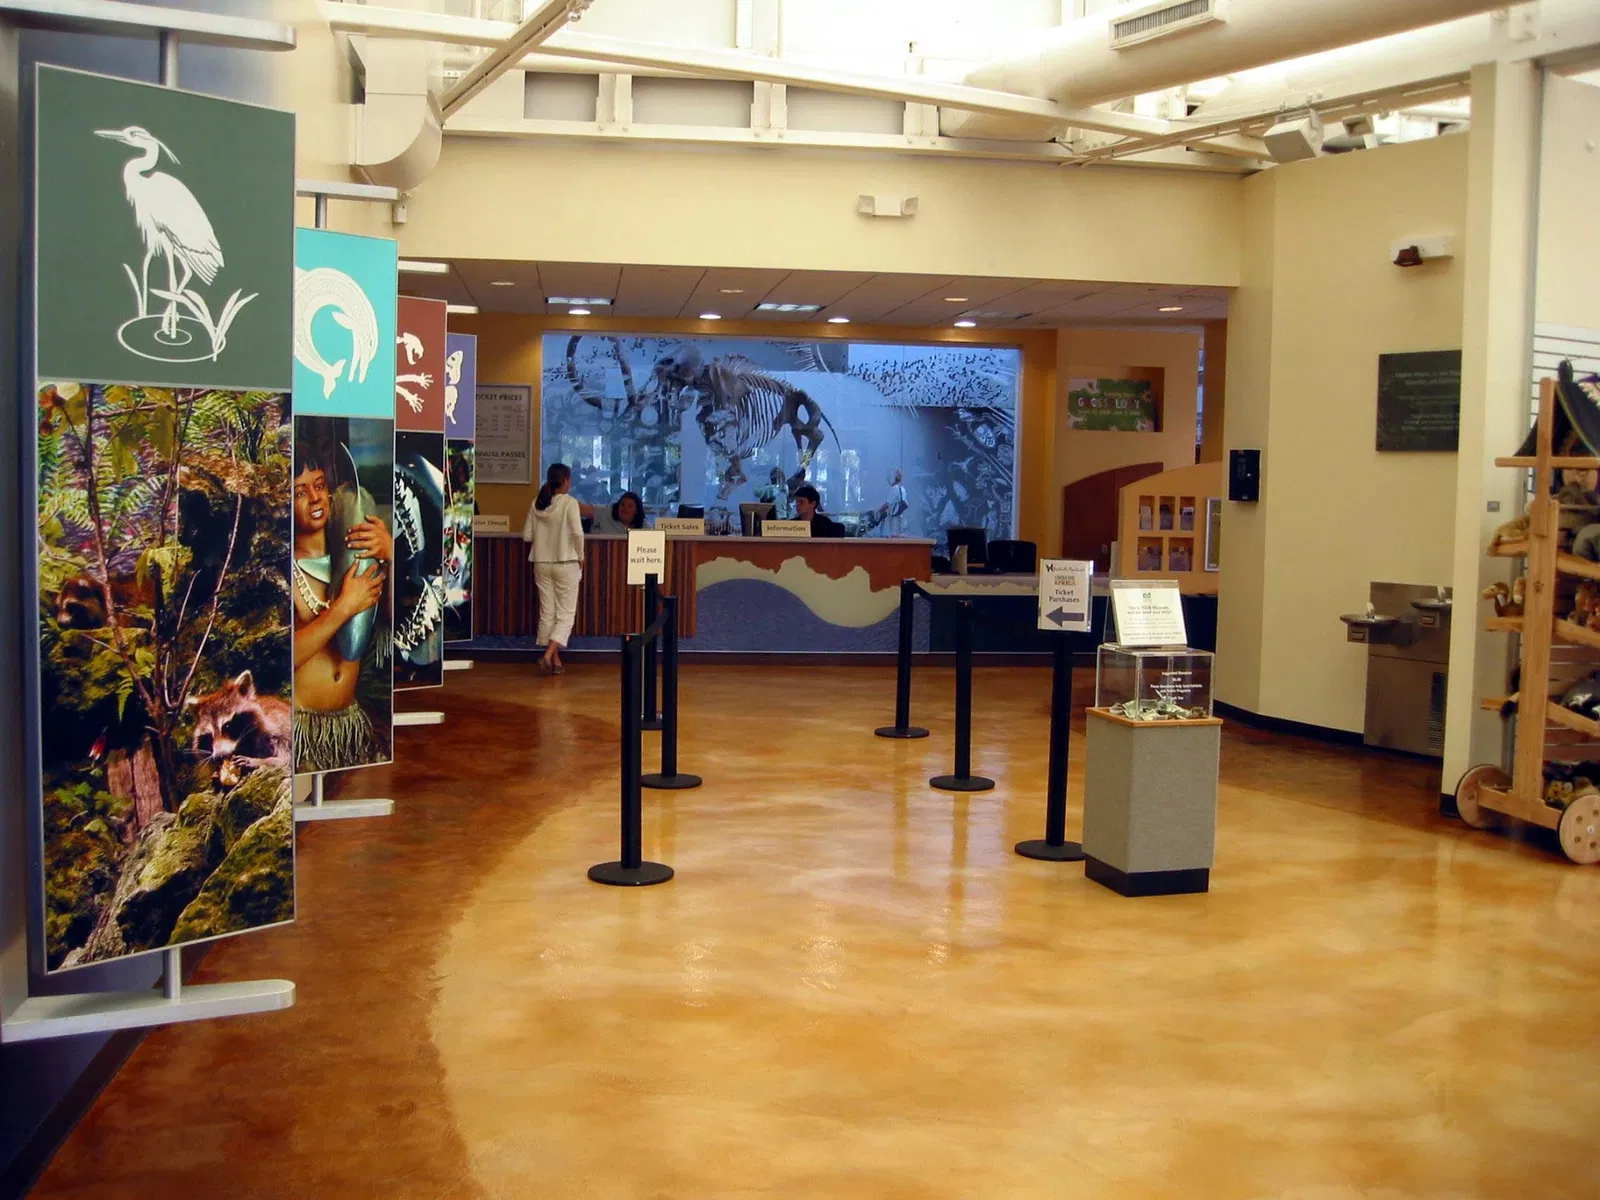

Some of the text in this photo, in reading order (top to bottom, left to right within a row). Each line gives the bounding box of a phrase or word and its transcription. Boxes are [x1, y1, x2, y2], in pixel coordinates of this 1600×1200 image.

[499, 393, 523, 401] PRICES
[660, 523, 699, 531] Ticket Sales
[766, 524, 806, 532] Information
[636, 546, 657, 554] Please
[630, 556, 662, 564] wait here.
[1055, 588, 1074, 596] Ticket
